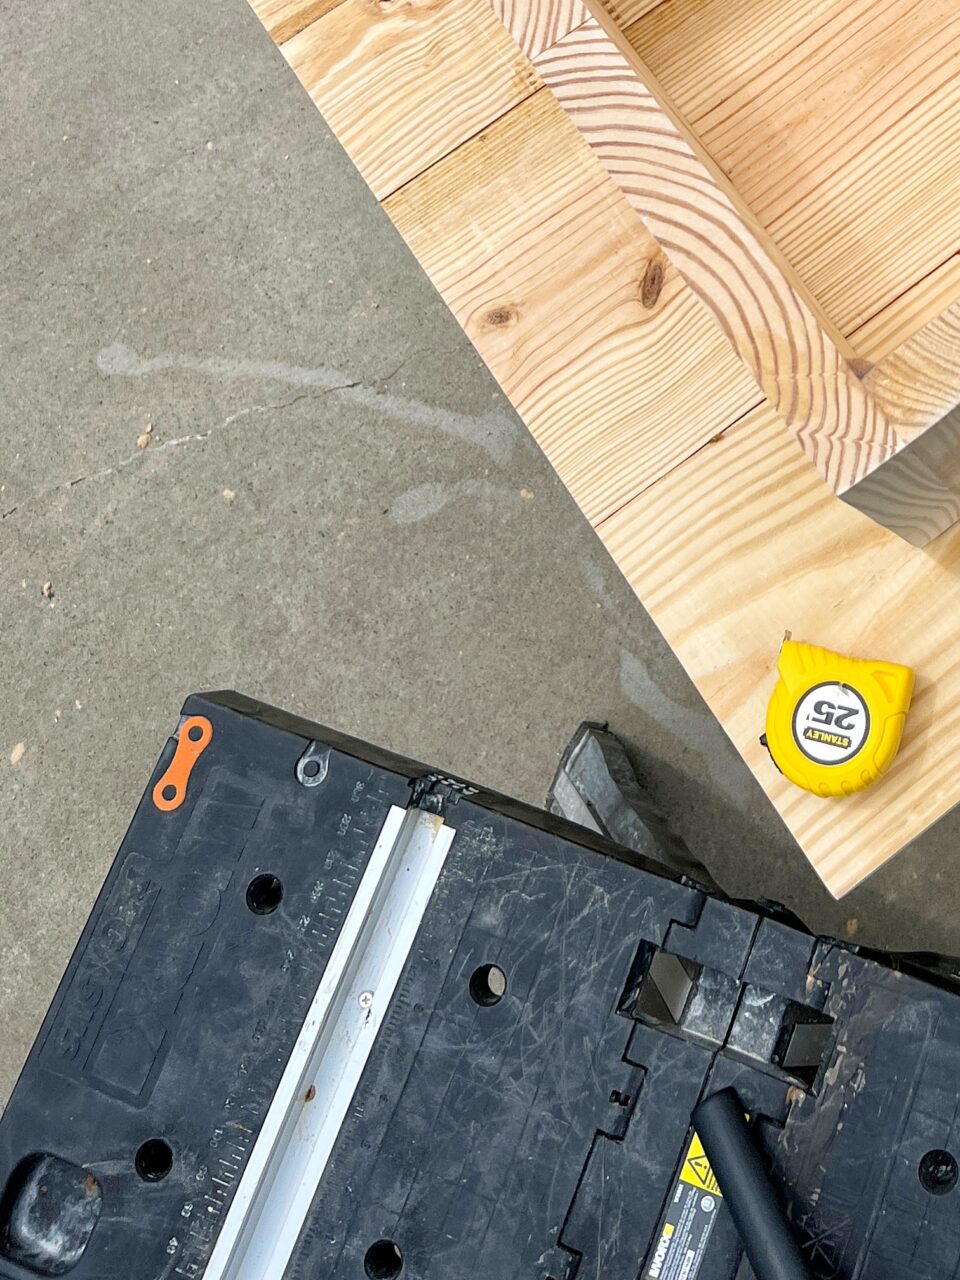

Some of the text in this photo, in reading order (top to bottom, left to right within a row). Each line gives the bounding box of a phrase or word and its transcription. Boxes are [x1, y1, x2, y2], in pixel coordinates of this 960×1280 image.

[805, 700, 860, 731] 25'
[805, 728, 850, 747] STANLEY
[166, 1236, 179, 1255] 40
[648, 1222, 675, 1278] WORX
